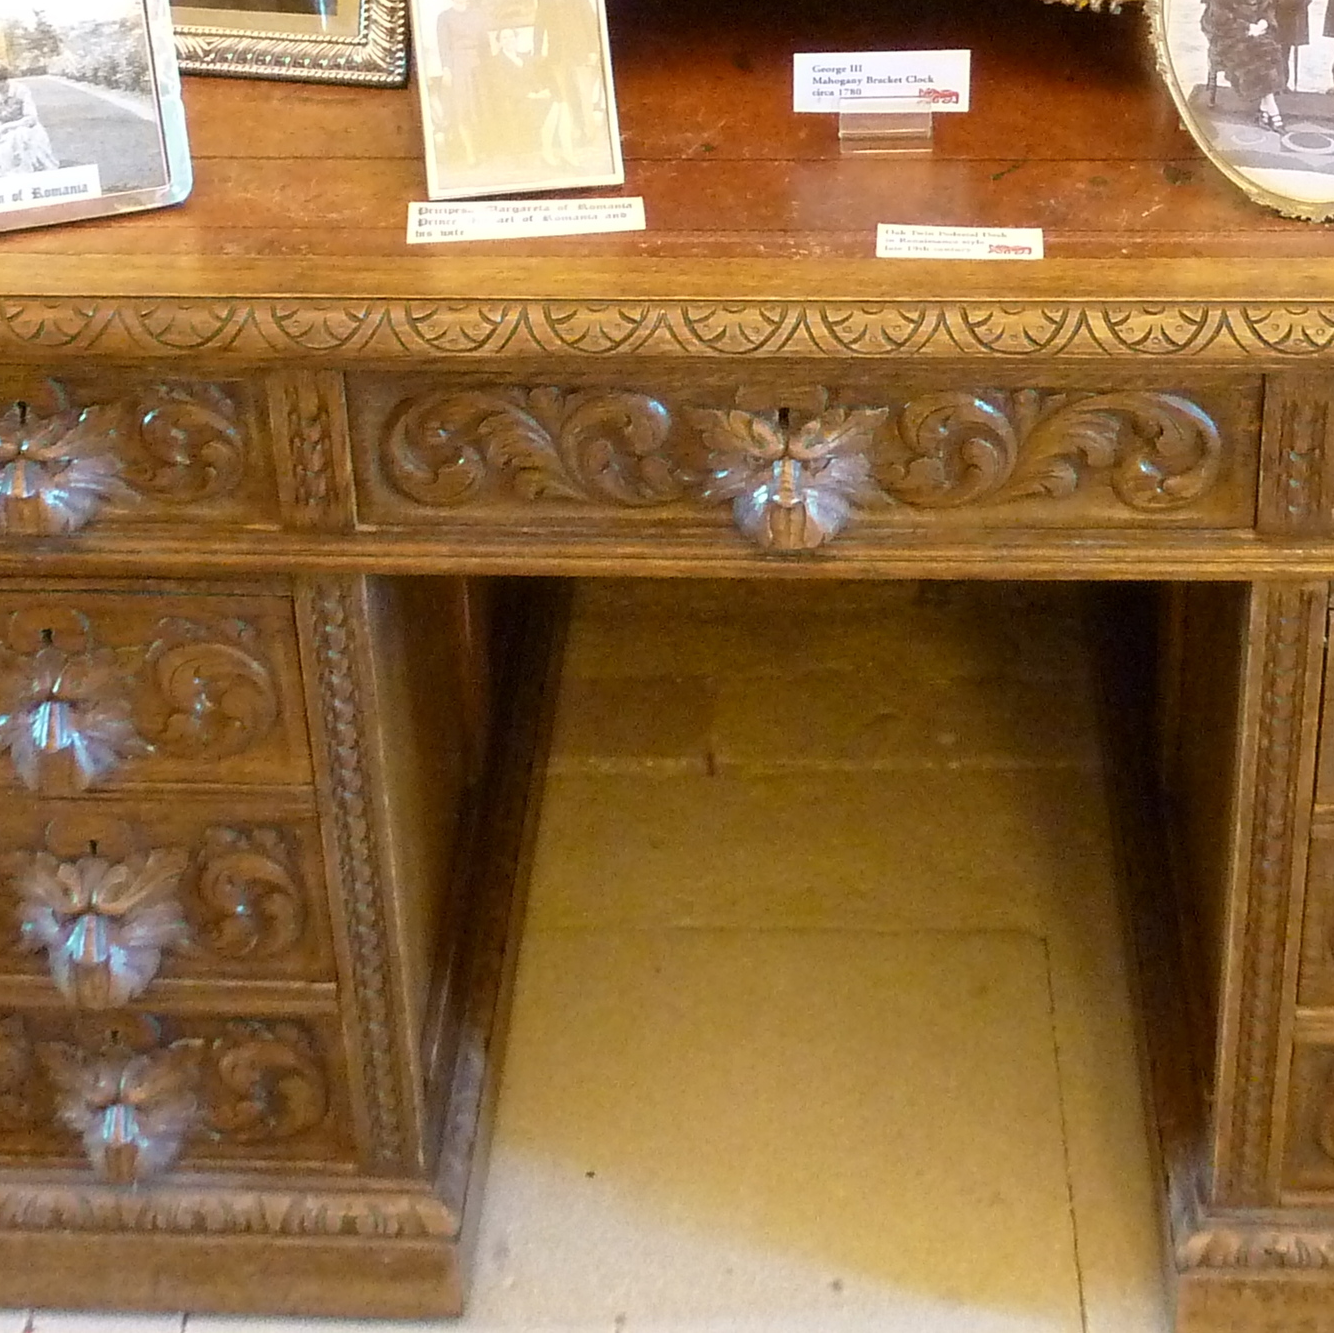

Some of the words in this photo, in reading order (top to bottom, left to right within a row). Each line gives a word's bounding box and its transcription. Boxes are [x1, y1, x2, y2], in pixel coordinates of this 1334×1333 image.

[812, 65, 847, 75] George
[850, 64, 863, 73] III
[812, 77, 863, 86] Mahogany
[866, 75, 903, 84] Bracket
[905, 74, 935, 84] Clock
[812, 88, 835, 96] circa
[838, 88, 863, 96] 1780
[11, 188, 24, 203] of
[31, 182, 89, 199] Romania
[557, 204, 568, 212] of
[578, 203, 633, 211] Romania
[418, 217, 457, 227] Prince
[542, 214, 598, 222] Romania
[415, 230, 433, 238] his
